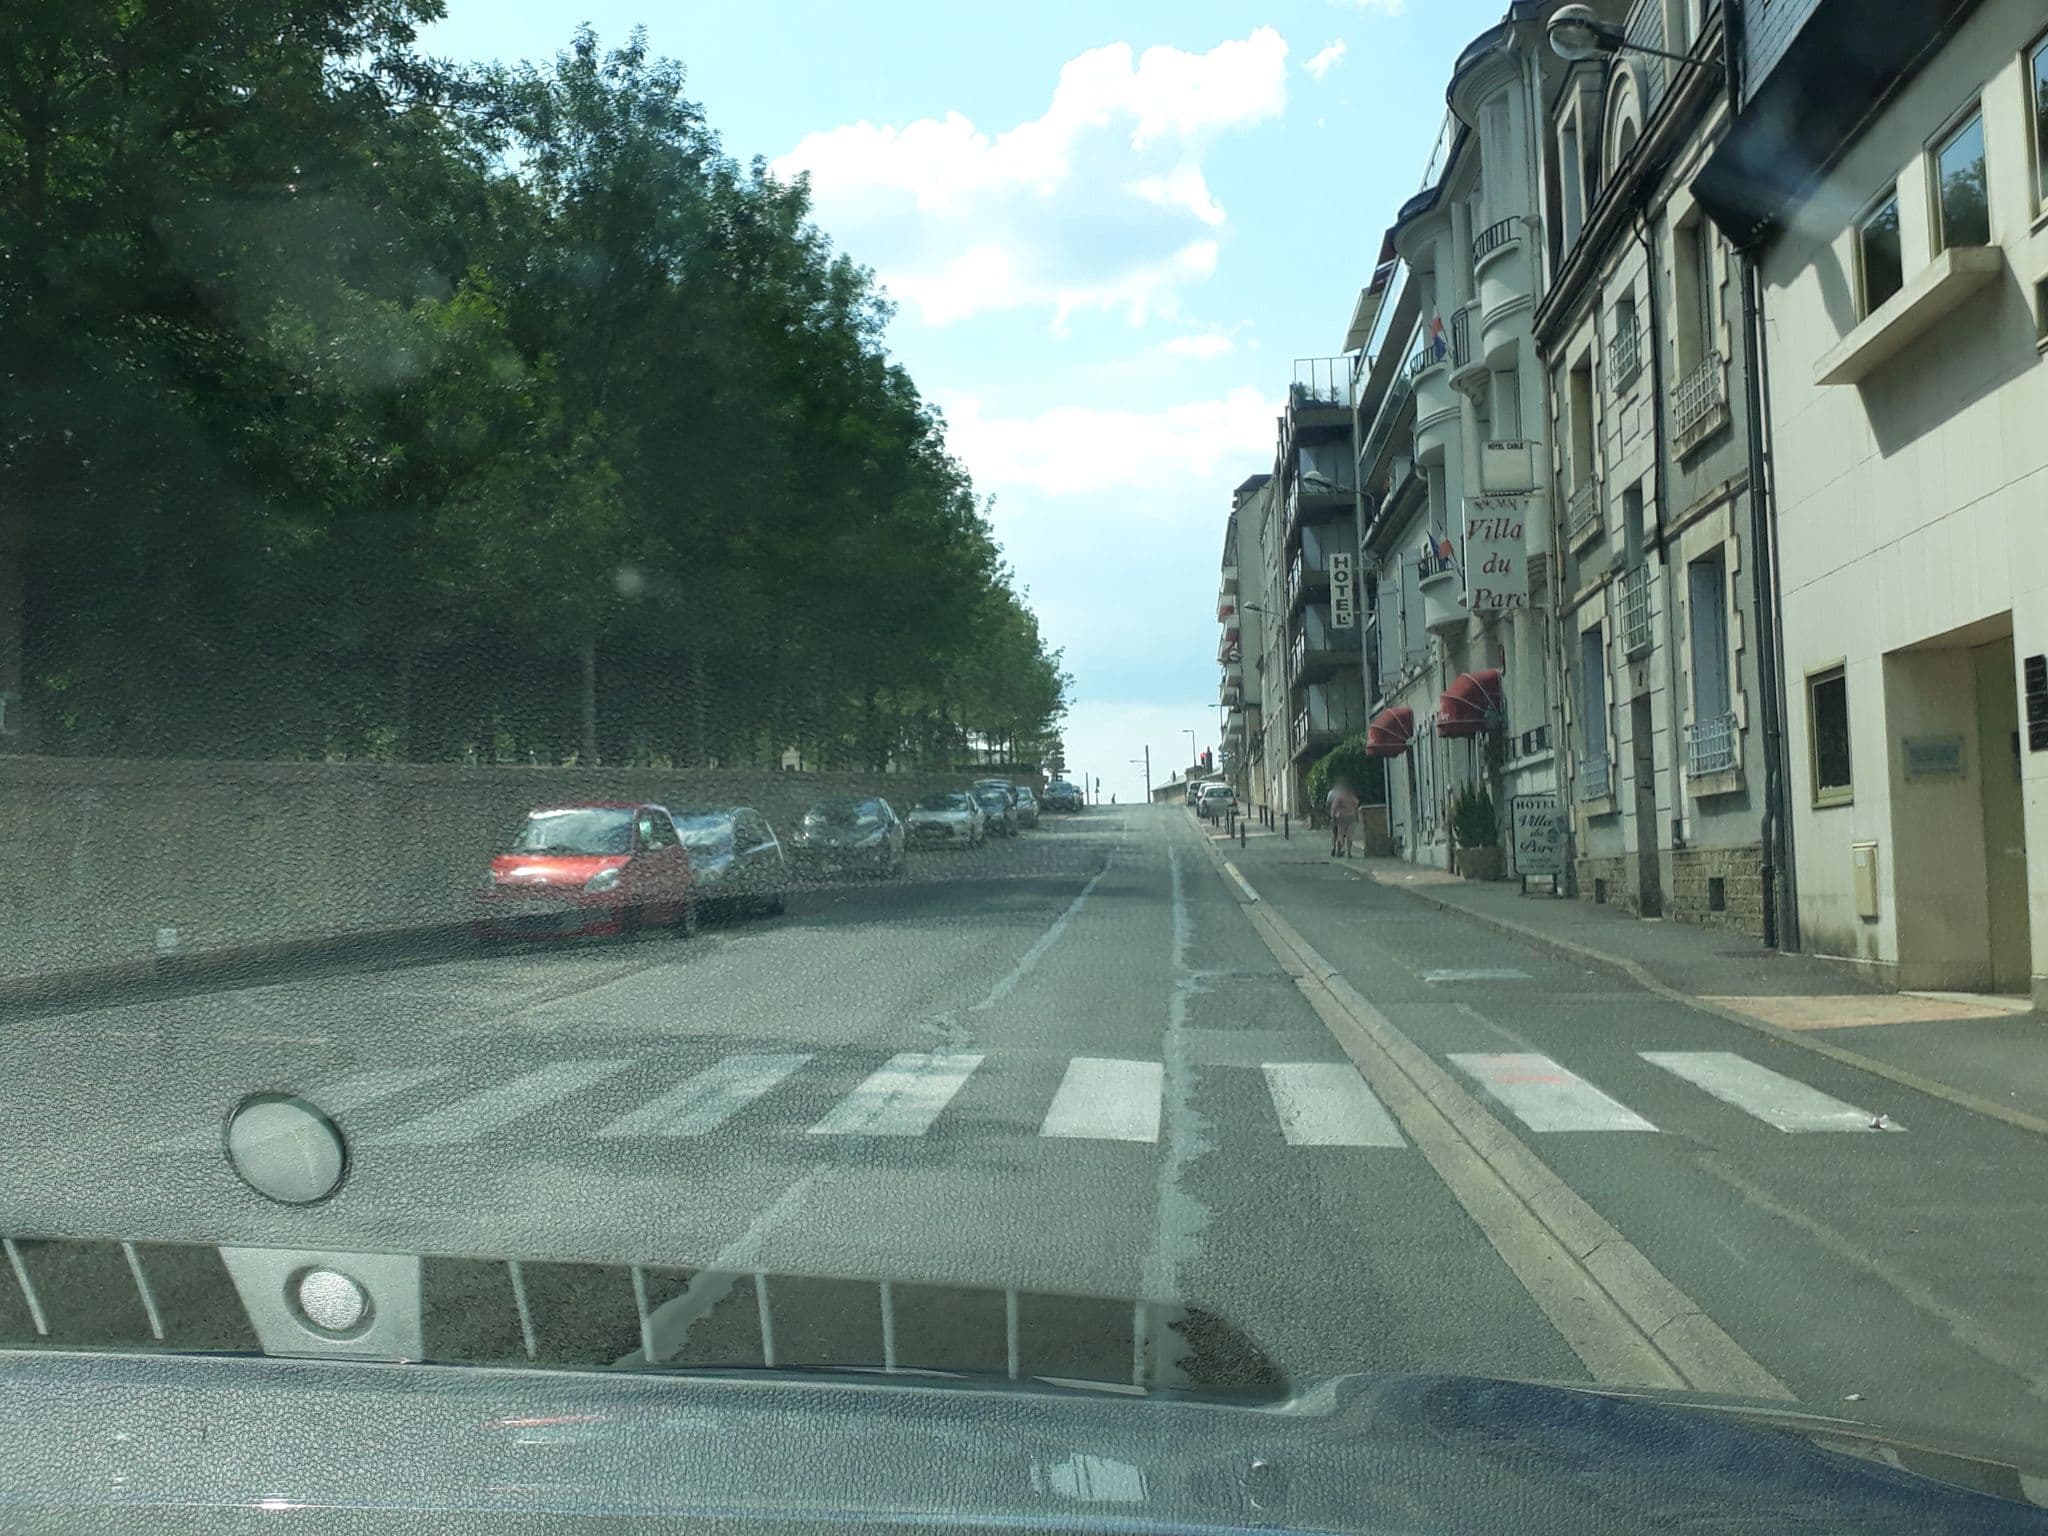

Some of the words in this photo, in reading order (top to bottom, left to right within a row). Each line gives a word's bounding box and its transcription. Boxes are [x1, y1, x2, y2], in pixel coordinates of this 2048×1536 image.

[1467, 517, 1523, 541] Villa
[1482, 551, 1512, 575] du
[1333, 556, 1350, 626] HOTEL
[1472, 588, 1527, 609] Parc
